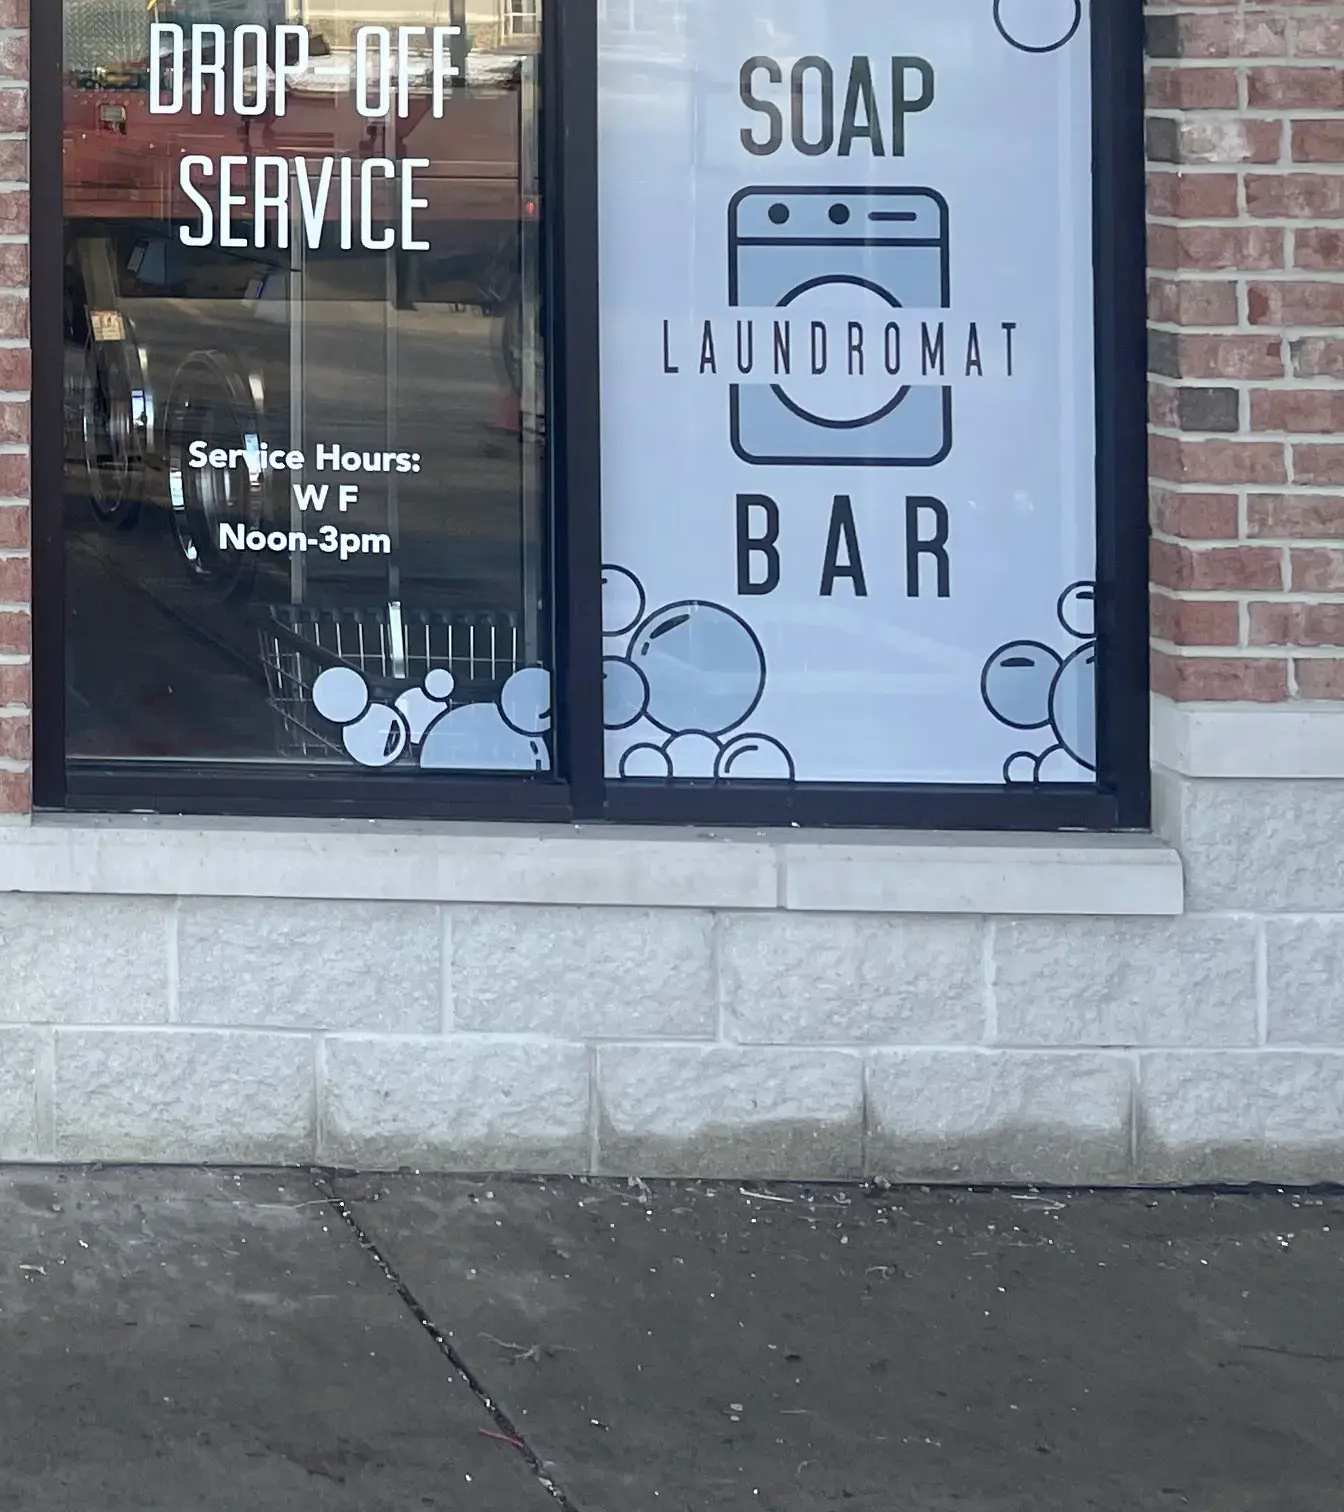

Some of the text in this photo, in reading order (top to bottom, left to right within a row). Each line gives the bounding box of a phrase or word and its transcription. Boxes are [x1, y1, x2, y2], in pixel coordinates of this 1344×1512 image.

[148, 22, 461, 118] DROP-OFF
[739, 55, 934, 157] SOAP
[179, 155, 430, 251] SERVICE
[663, 320, 1018, 378] LAUNDROMAT
[188, 441, 421, 473] Service Hours:
[293, 485, 358, 512] W F
[219, 522, 391, 559] Noon-3pm
[736, 495, 951, 598] BAR
